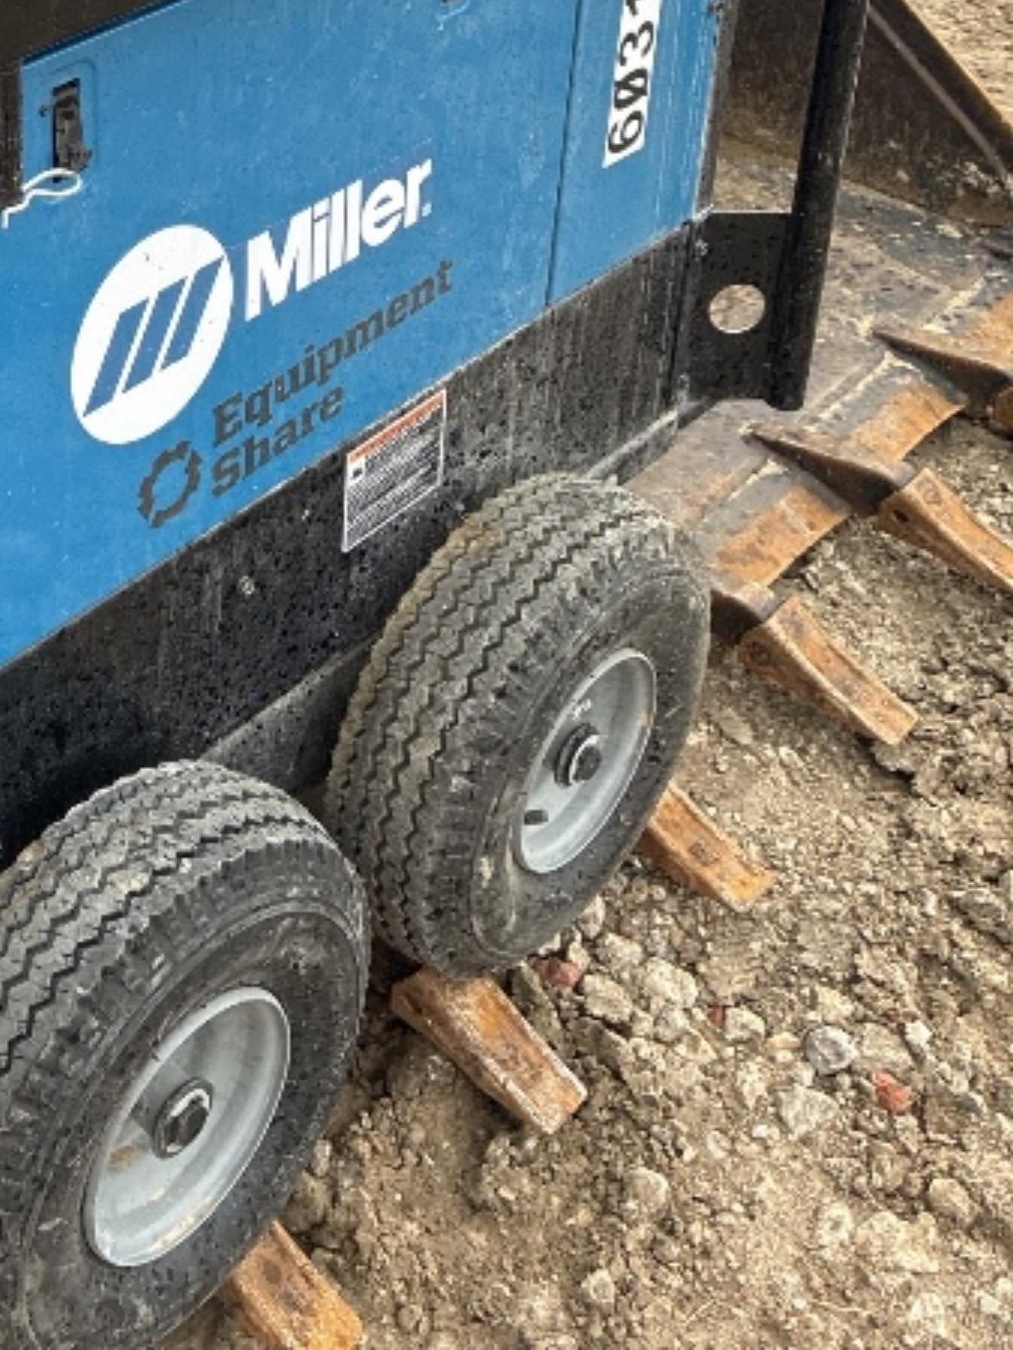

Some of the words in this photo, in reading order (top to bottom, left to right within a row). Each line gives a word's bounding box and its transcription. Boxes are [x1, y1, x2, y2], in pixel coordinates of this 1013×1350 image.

[245, 159, 432, 321] Miller
[212, 260, 454, 447] Equipment
[211, 385, 345, 497] Share
